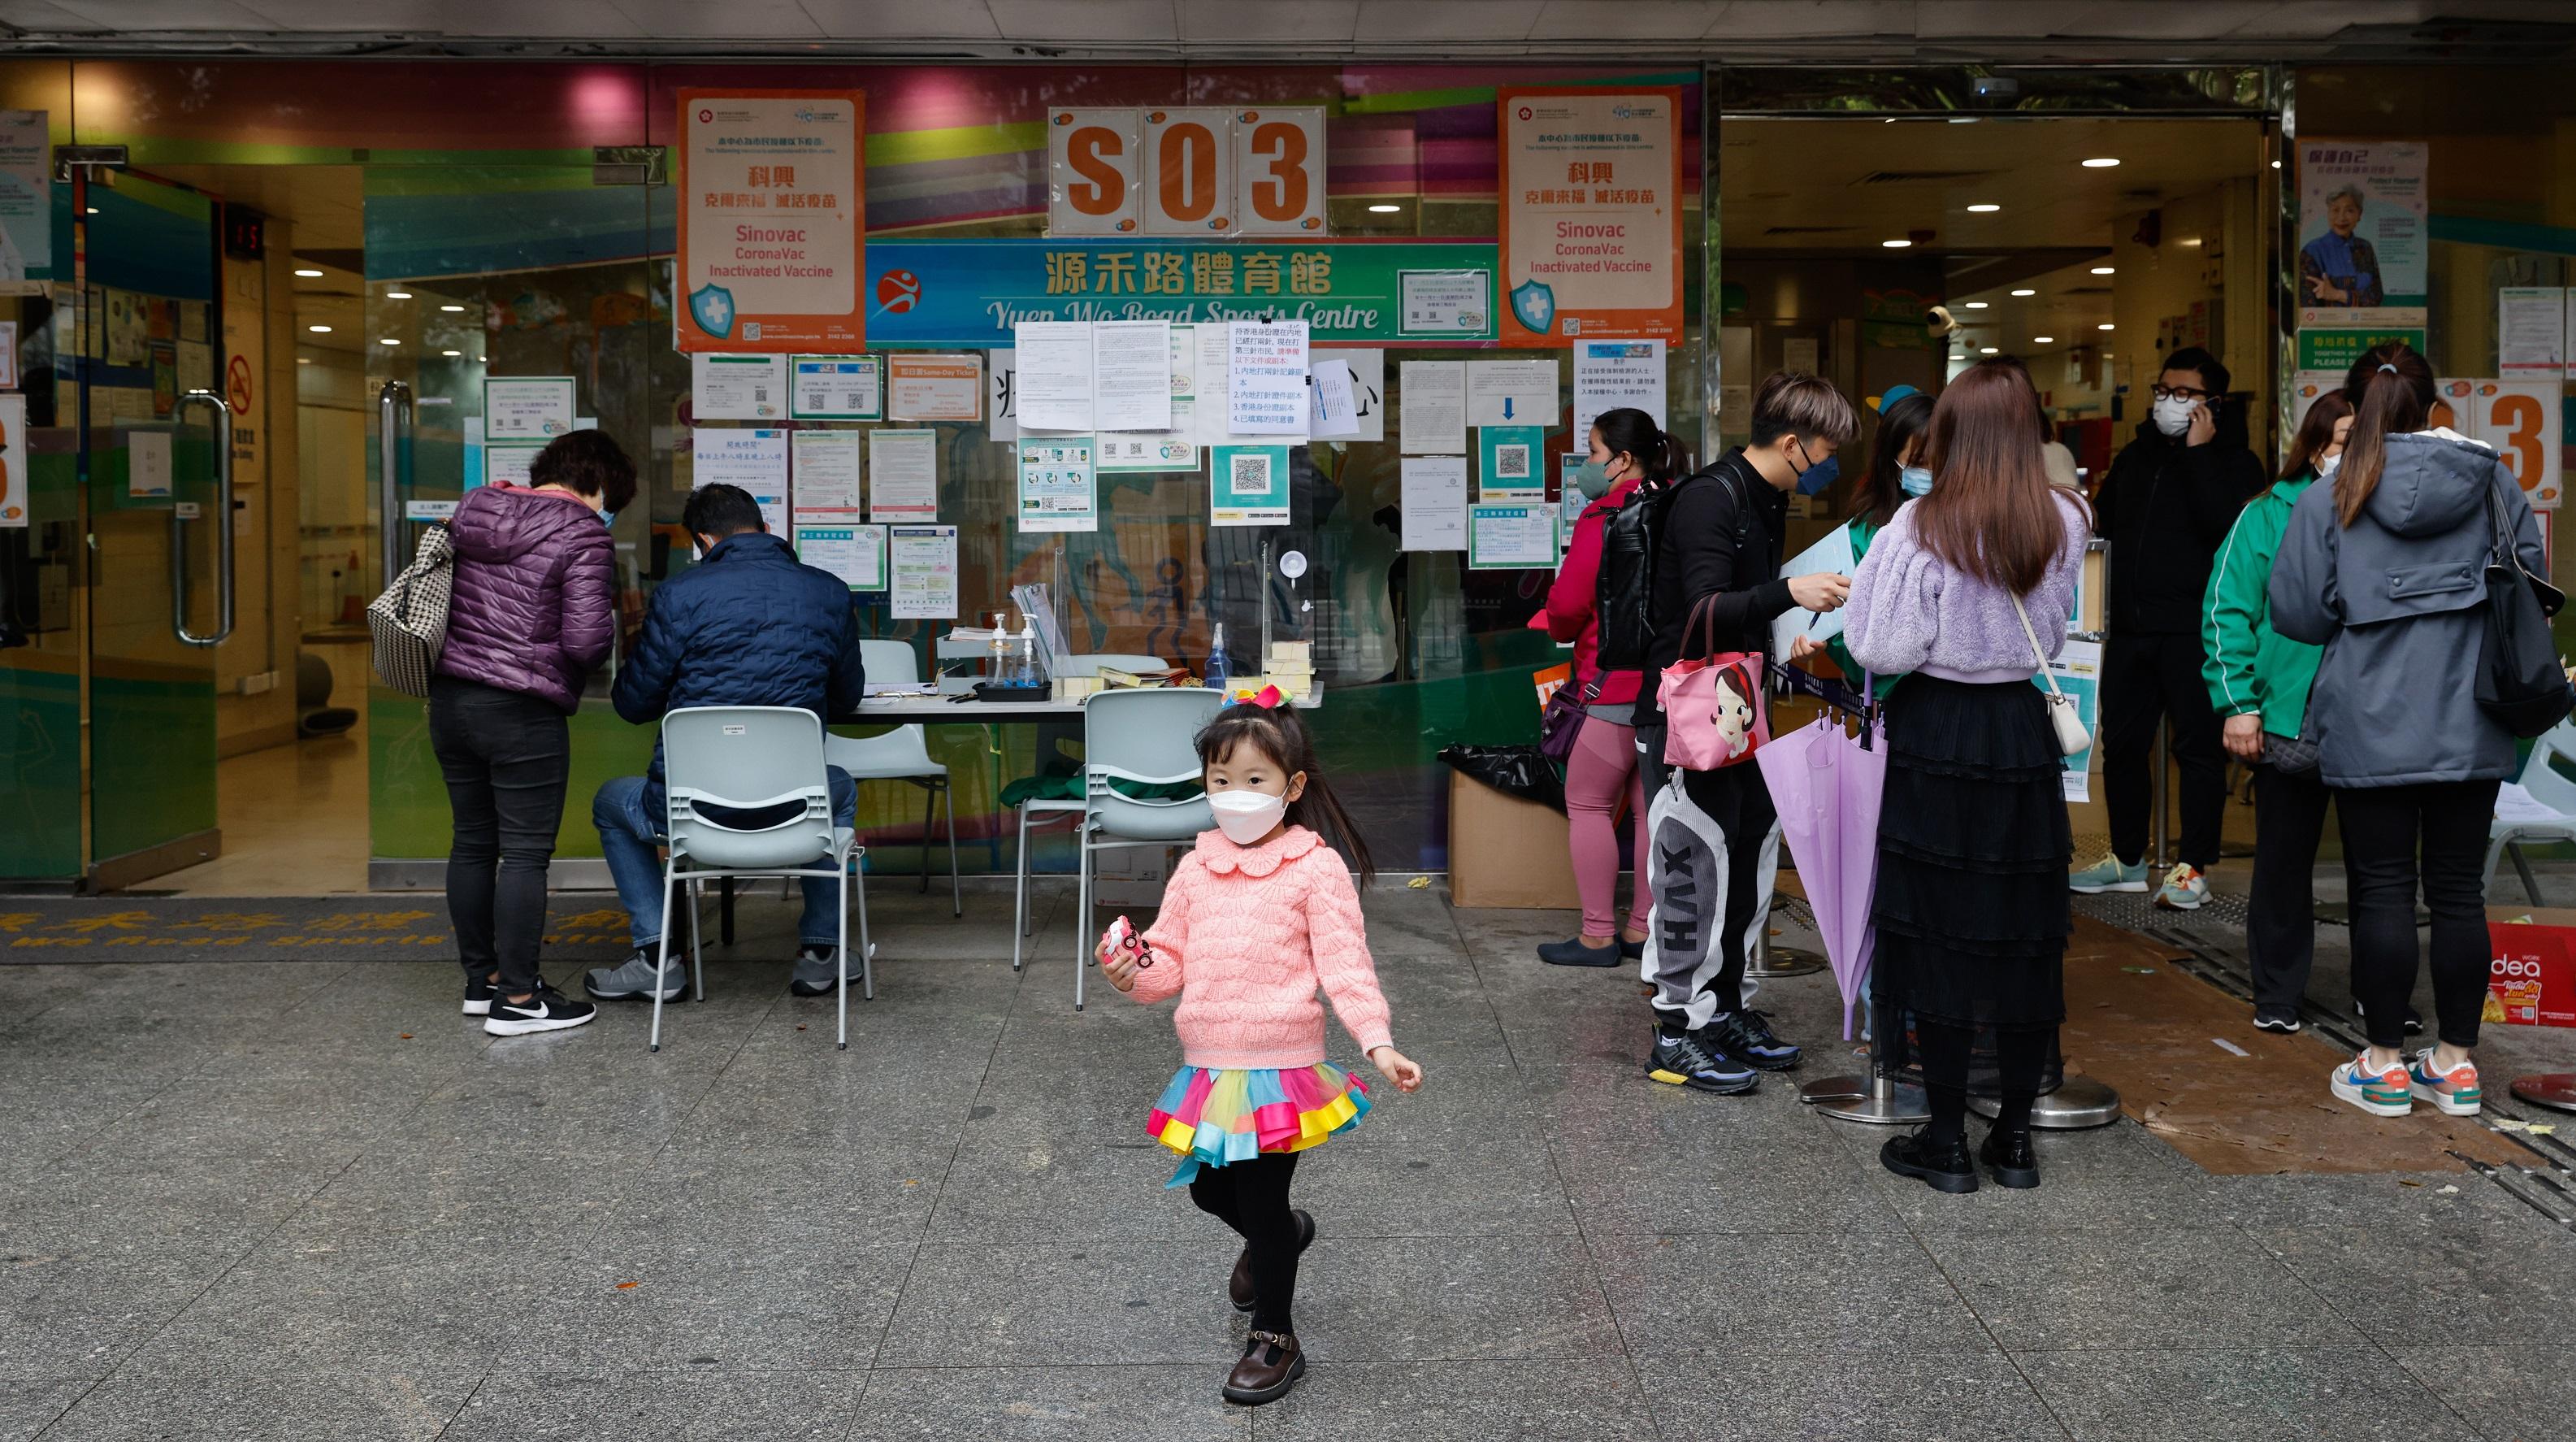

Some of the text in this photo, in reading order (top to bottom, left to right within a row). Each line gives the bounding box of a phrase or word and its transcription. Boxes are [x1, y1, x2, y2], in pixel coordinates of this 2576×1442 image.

[748, 166, 795, 188] 科興
[1067, 124, 1308, 221] S03
[1568, 162, 1613, 184] 科興
[736, 224, 806, 242] Sinovac
[1556, 221, 1625, 238] Sinovac
[735, 247, 805, 259] CoronaVac
[1555, 243, 1624, 255] CoronaVac
[709, 264, 834, 278] Inactivated Vaccine
[1045, 250, 1333, 296] 源禾路體育館
[1530, 259, 1652, 273] Inactivated Vaccine
[987, 302, 1055, 330] Yuen
[1065, 302, 1119, 324] Wo
[1295, 301, 1379, 330] Centre
[2490, 394, 2543, 493] 3
